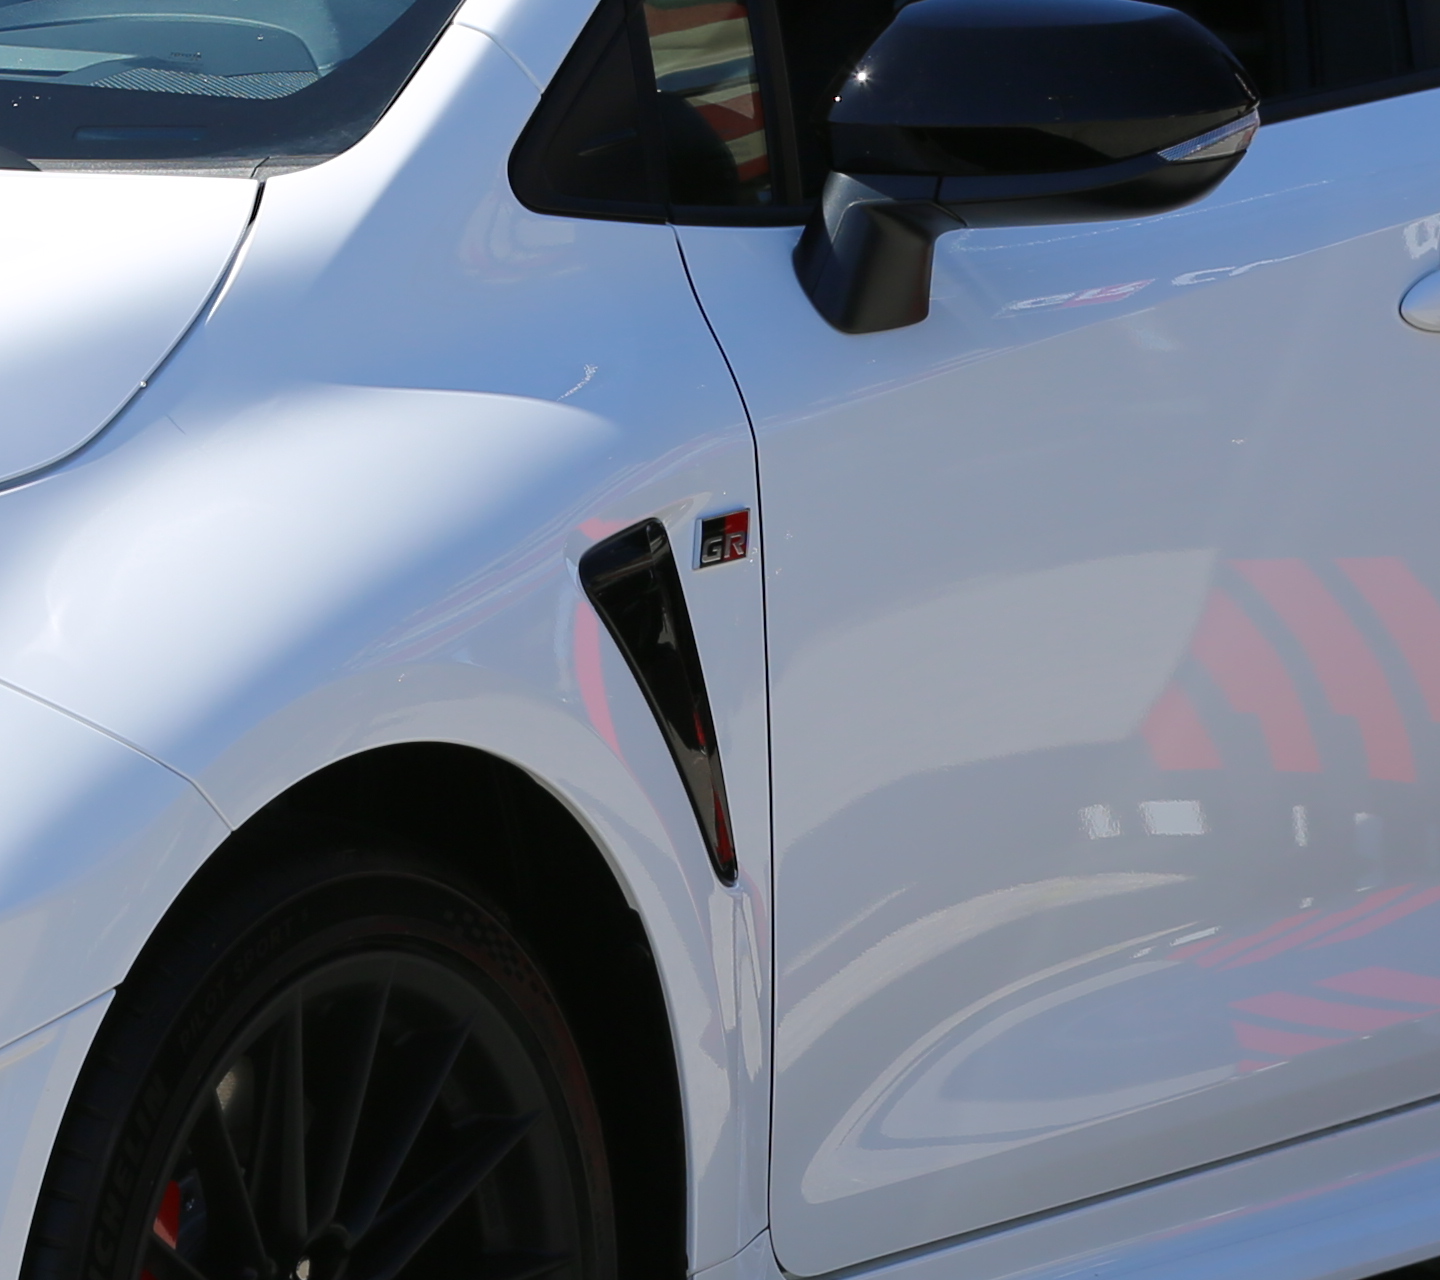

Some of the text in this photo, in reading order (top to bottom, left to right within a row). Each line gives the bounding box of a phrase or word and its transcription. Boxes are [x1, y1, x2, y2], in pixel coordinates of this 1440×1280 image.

[701, 530, 747, 564] GR
[178, 974, 229, 1055] PILOT
[232, 916, 295, 982] SPORT
